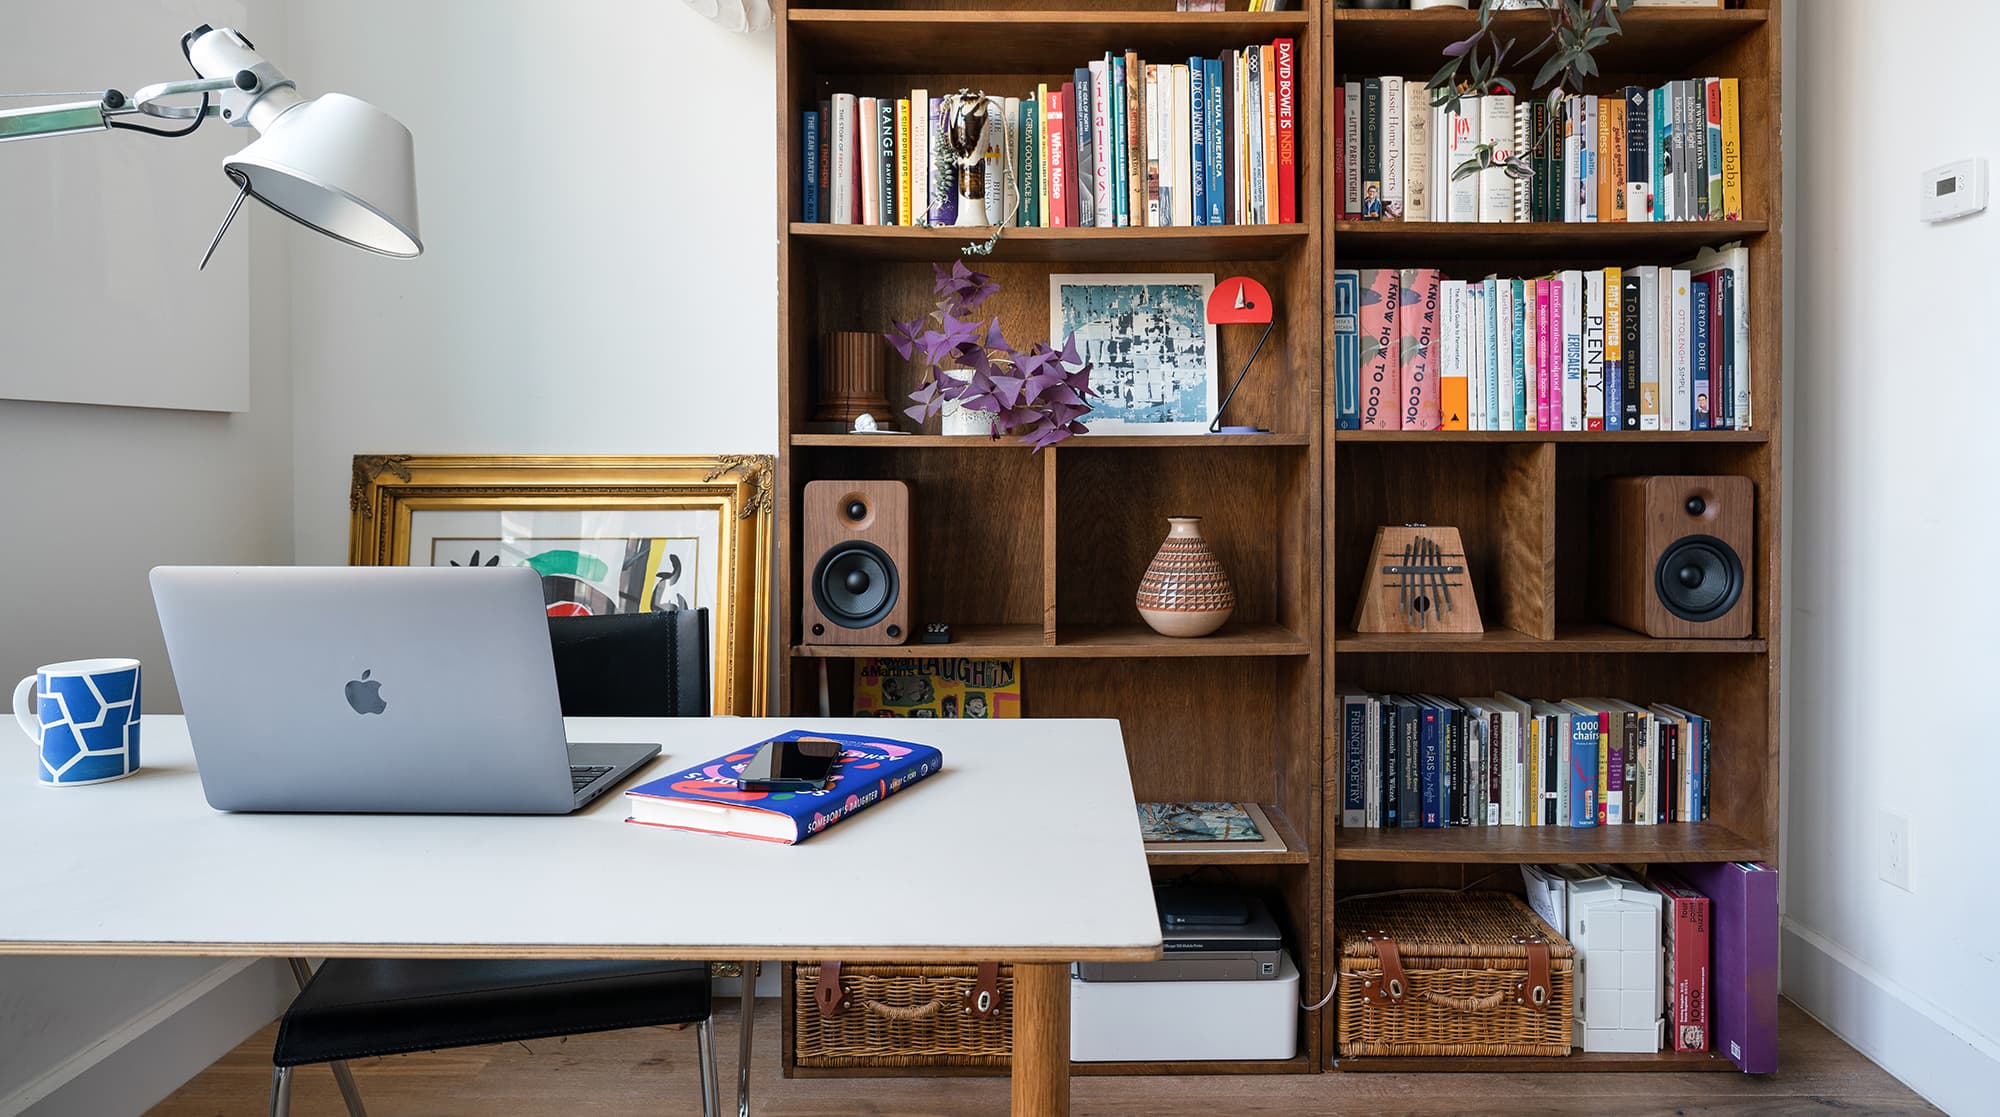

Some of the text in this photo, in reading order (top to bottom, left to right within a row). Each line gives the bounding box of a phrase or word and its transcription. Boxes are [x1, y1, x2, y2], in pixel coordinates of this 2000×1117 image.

[1280, 43, 1292, 166] DAVID BOWIE IS INSIDE
[1368, 94, 1376, 131] BAKING
[1673, 96, 1682, 149] kitchen light
[1687, 96, 1696, 149] kitchen light
[882, 106, 893, 157] RANGE
[1388, 79, 1399, 191] Classic Home Desserts
[1599, 103, 1609, 154] meatless
[1052, 132, 1062, 199] White Noise
[1368, 144, 1376, 173] DORIE
[1726, 141, 1738, 188] sababa
[1384, 283, 1399, 323] KNOW
[1423, 283, 1438, 323] KNOW
[1608, 285, 1620, 346] ARTY PARTIES
[1377, 327, 1391, 360] HOW
[1417, 327, 1431, 360] HOW
[1551, 285, 1561, 392] barefoot contessa foolproof
[1697, 292, 1706, 370] EVERYDAY DORIE
[1373, 363, 1385, 382] TO
[1413, 363, 1425, 382] TO
[1515, 353, 1522, 366] IN
[1567, 333, 1580, 380] JERUSALEM
[1588, 315, 1602, 392] PLENTY
[1627, 350, 1635, 389] CULT RECIPES
[1365, 386, 1381, 425] COOK
[1406, 386, 1421, 425] COOK
[1573, 731, 1600, 741] chairs
[1576, 721, 1598, 731] 1000
[1350, 710, 1360, 804] FRENCH POETRY
[1424, 745, 1436, 803] PARIS by Night
[807, 805, 848, 833] SOMEBODY'S
[850, 790, 878, 812] DAUGHTER
[1680, 902, 1688, 918] four
[1691, 989, 1700, 1023] 1000
